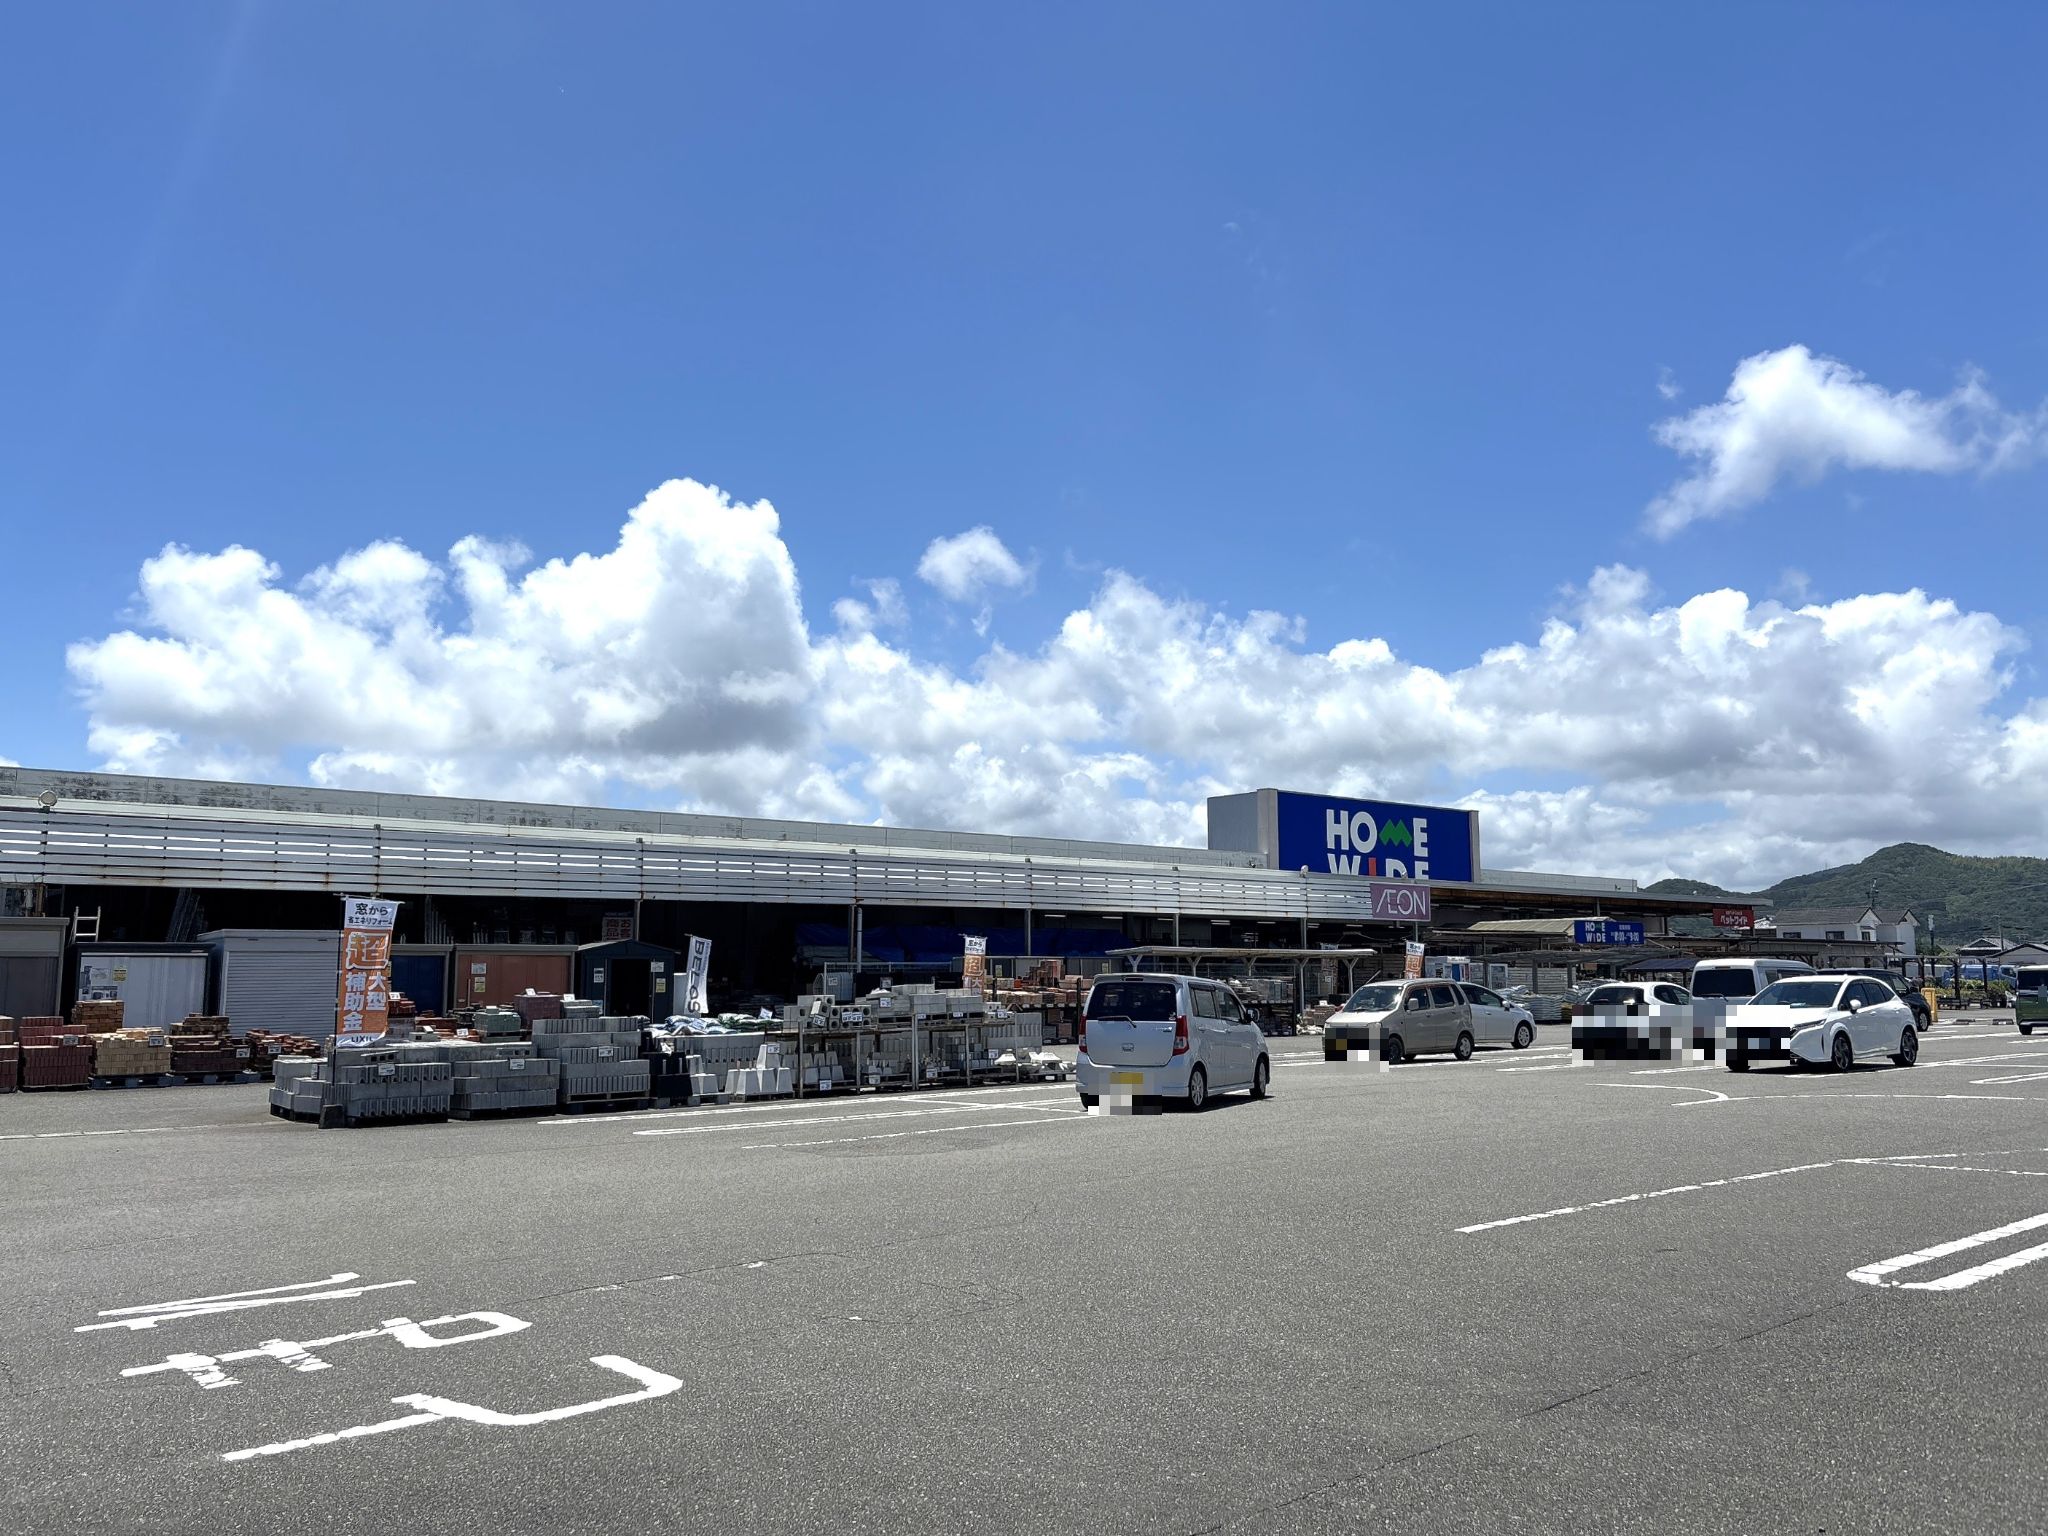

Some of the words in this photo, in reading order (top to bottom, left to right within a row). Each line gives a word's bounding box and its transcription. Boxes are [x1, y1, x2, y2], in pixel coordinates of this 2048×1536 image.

[1326, 808, 1429, 857] HOME
[354, 903, 389, 916] 窓から
[1584, 922, 1606, 932] HOME
[1585, 932, 1606, 943] WIDE
